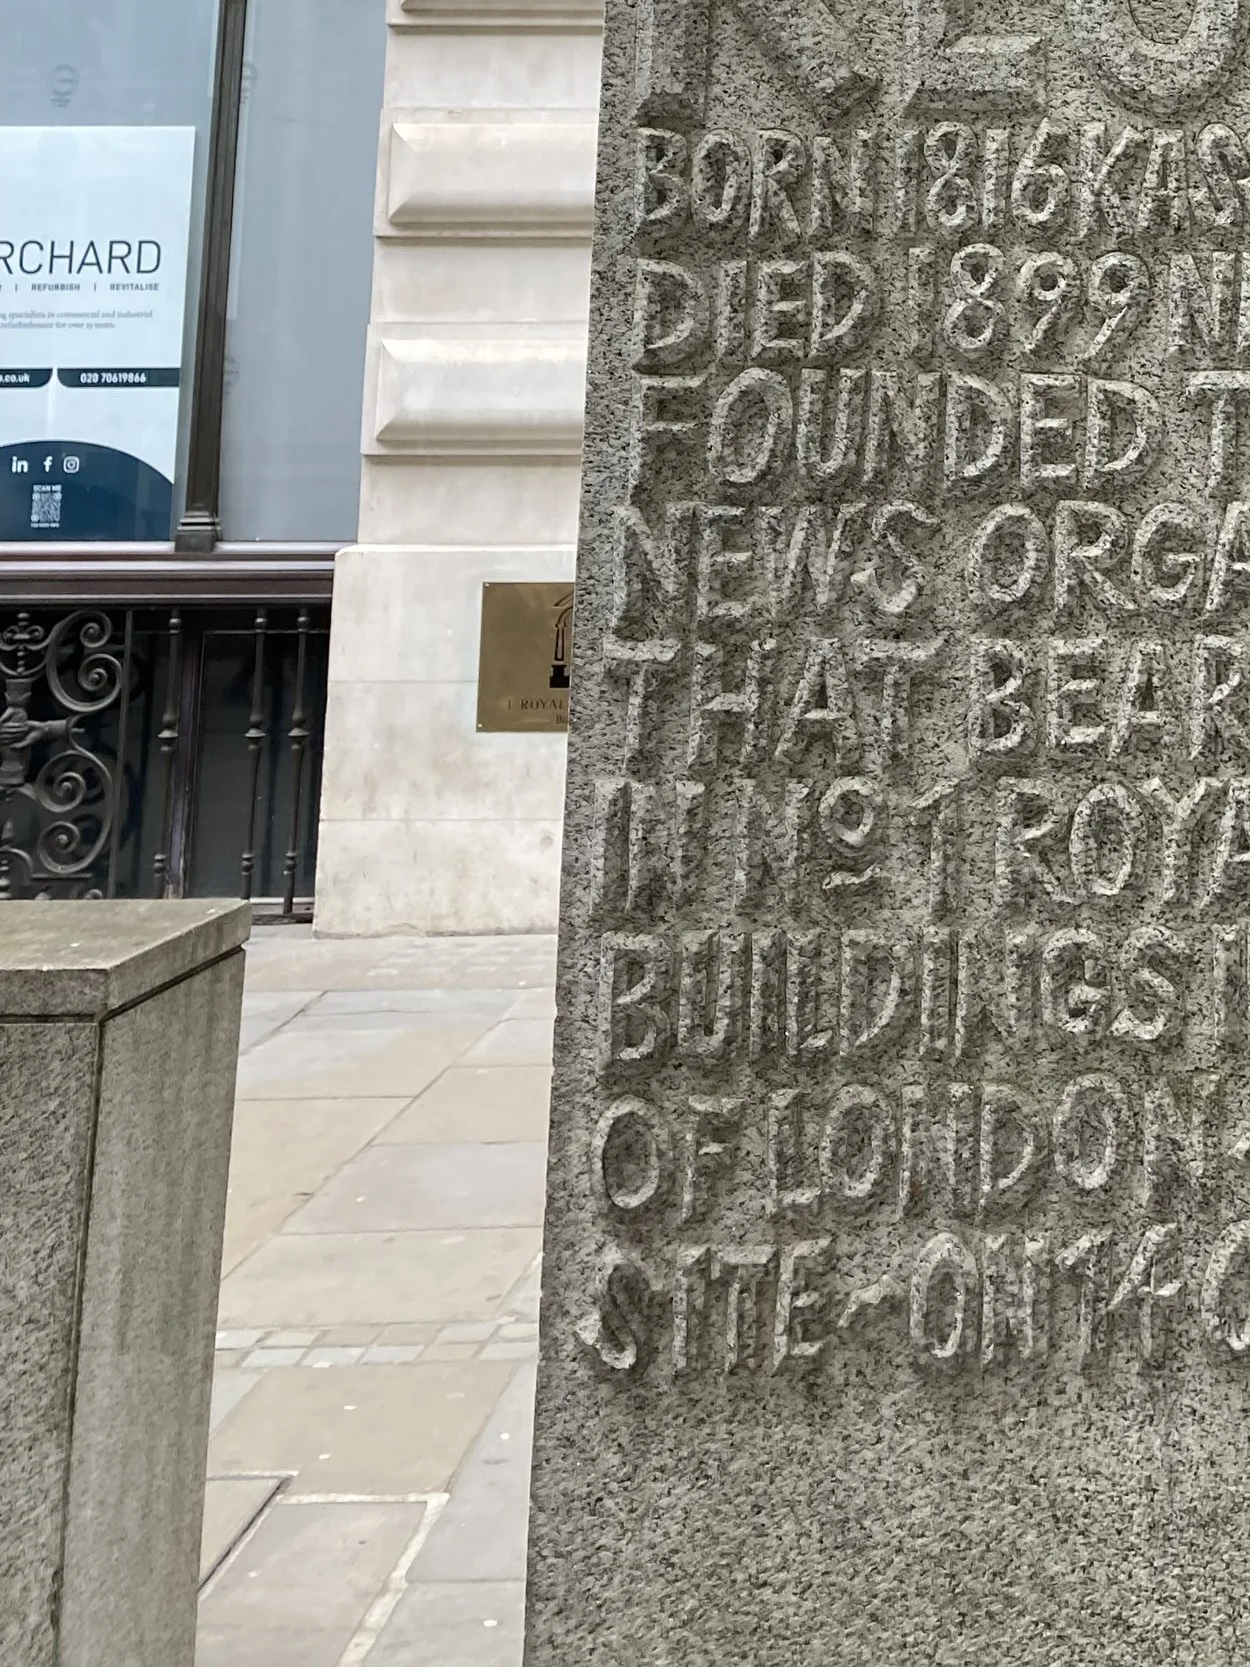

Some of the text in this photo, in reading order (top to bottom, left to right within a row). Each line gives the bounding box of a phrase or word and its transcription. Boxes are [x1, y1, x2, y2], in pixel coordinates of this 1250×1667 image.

[633, 126, 875, 237] BORN
[901, 115, 1072, 235] 1816
[0, 239, 163, 275] RCHARD
[31, 283, 160, 291] REFURBISH REVITALISE
[632, 250, 876, 366] DIED
[907, 242, 1154, 360] 1899
[80, 373, 147, 384] 020 70619866
[630, 366, 1167, 500] FOUNDED
[605, 498, 944, 633] NEWS
[601, 634, 945, 775] THAT
[597, 926, 1209, 1064] BUILDINGS
[592, 1092, 748, 1227] OF
[768, 1072, 1222, 1222] LONDON
[576, 1236, 833, 1376] SITE
[908, 1232, 1050, 1368] ON
[1052, 1221, 1185, 1360] 14
